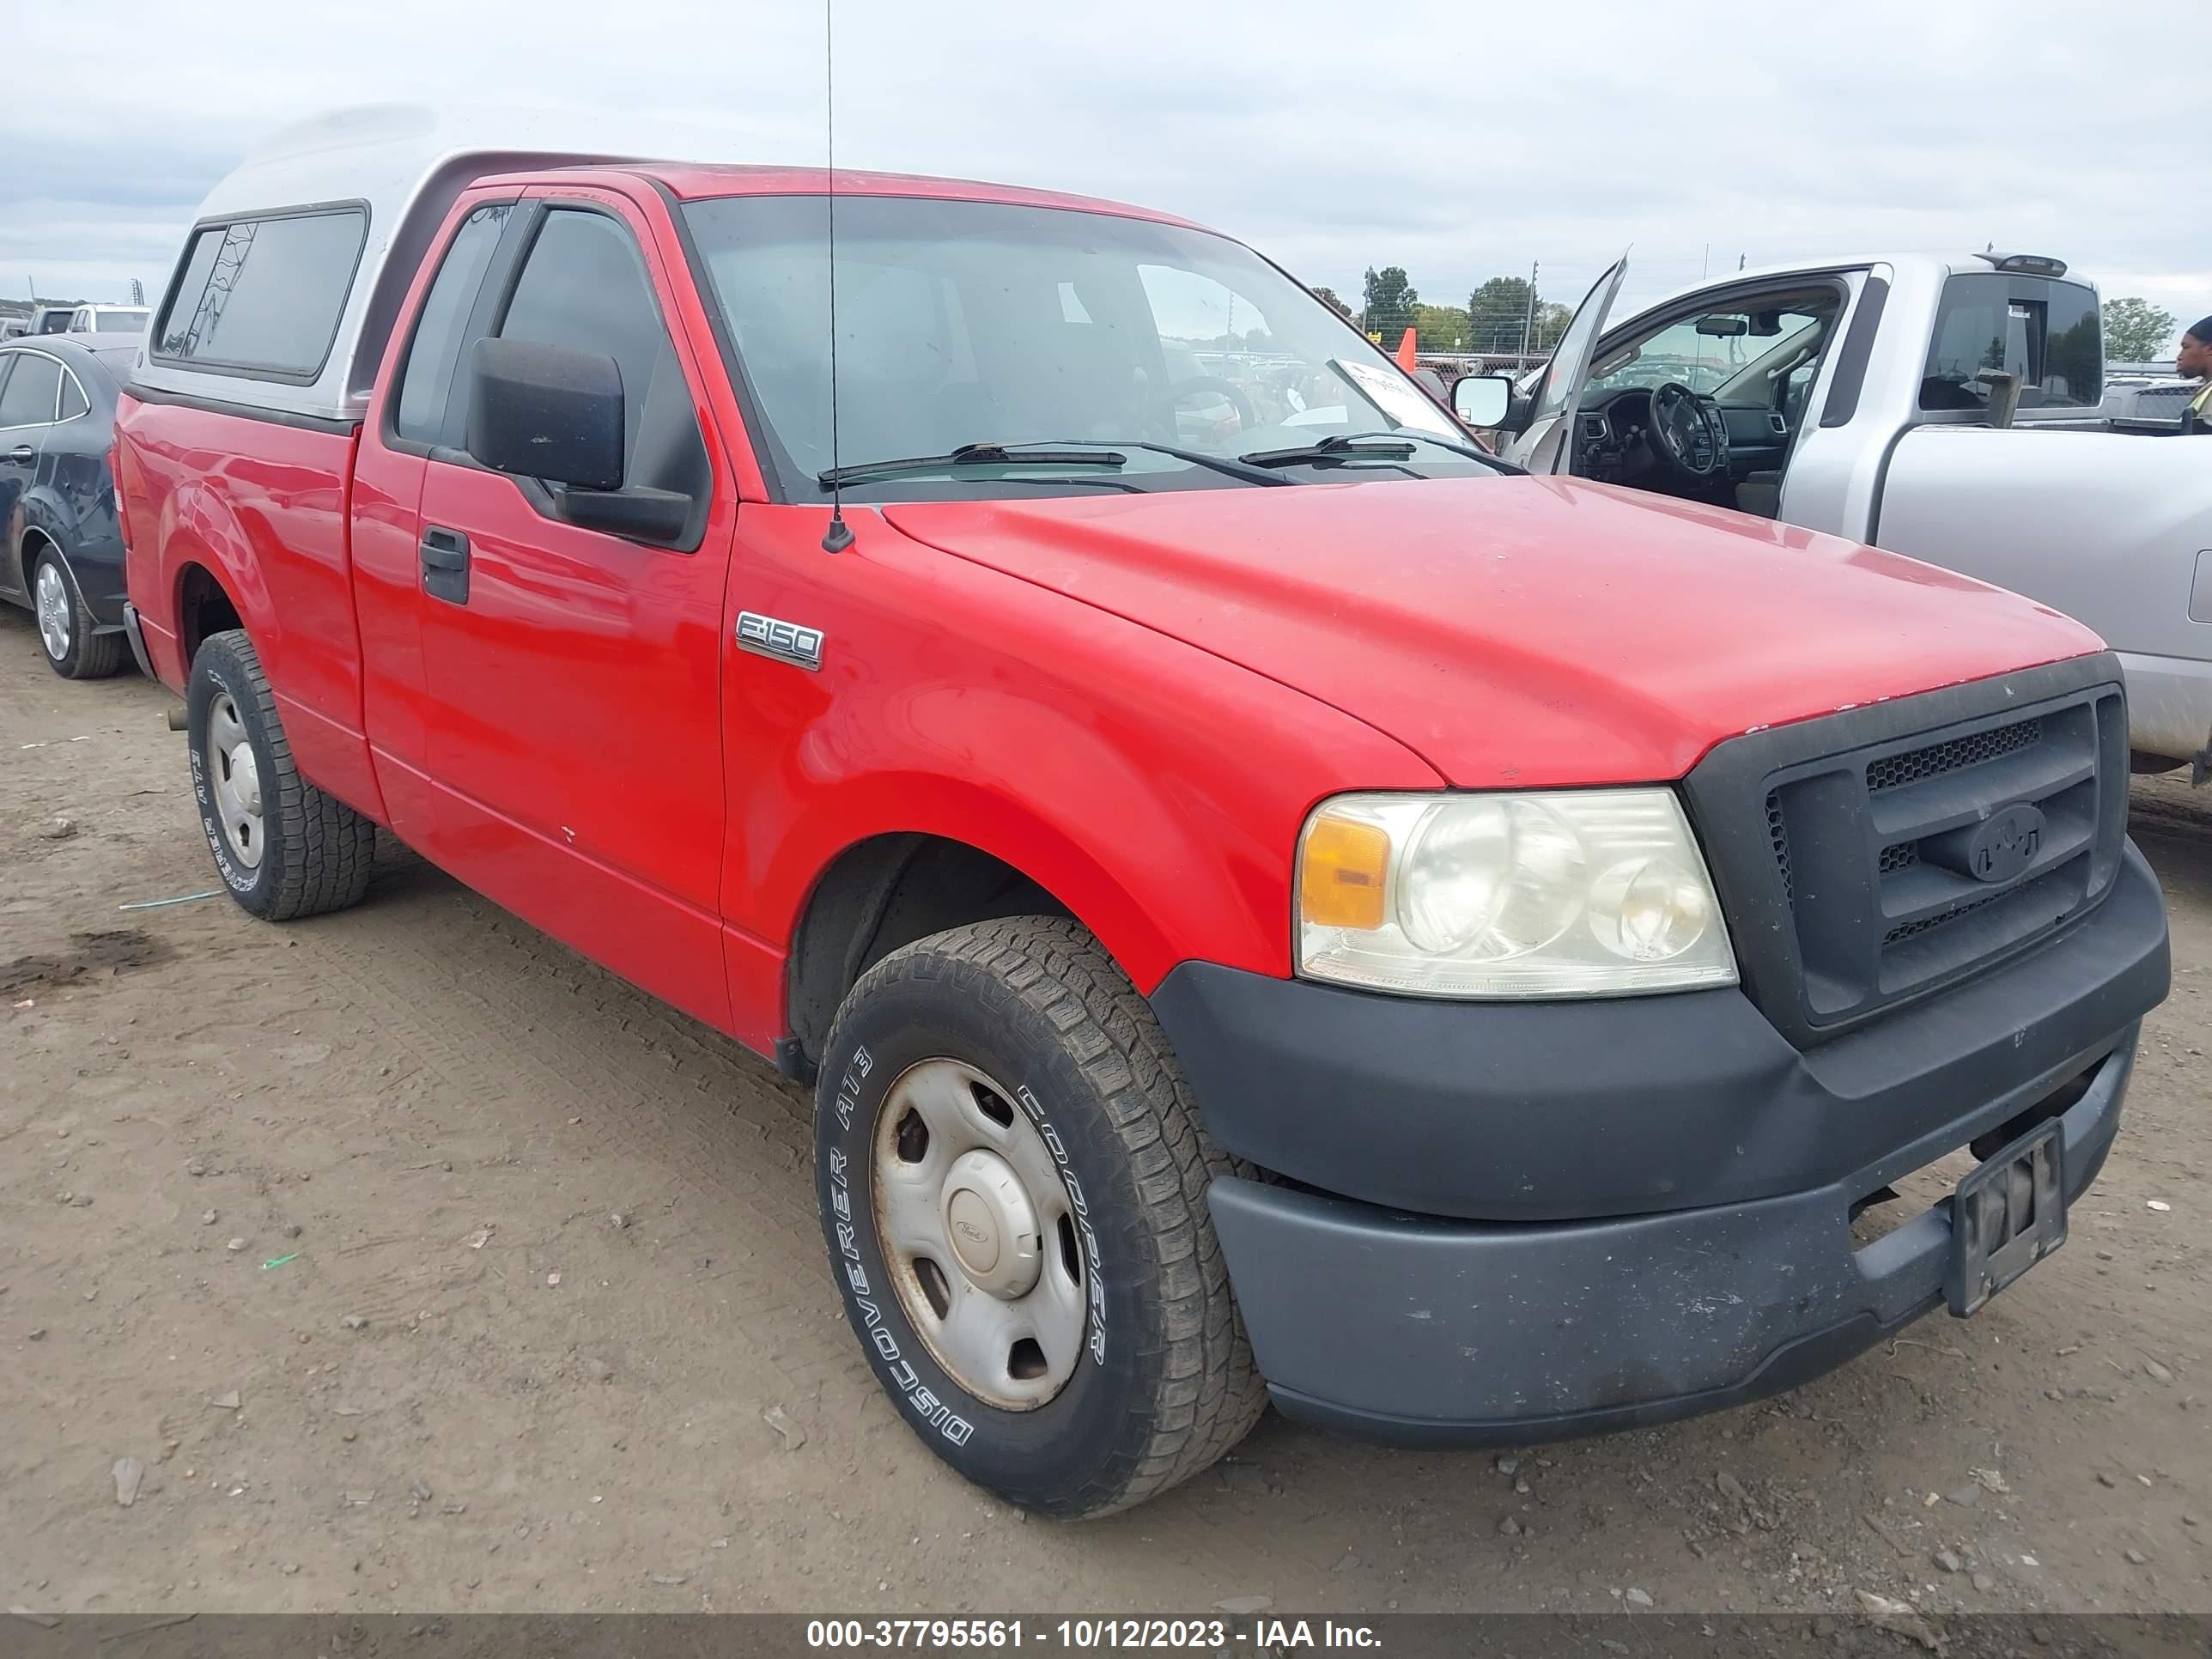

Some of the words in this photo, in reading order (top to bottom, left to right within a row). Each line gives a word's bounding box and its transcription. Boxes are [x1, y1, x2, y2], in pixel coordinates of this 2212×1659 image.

[737, 612, 820, 657] F-150
[830, 1147, 975, 1448] DISCOVERER
[1018, 1084, 1106, 1366] COOPER
